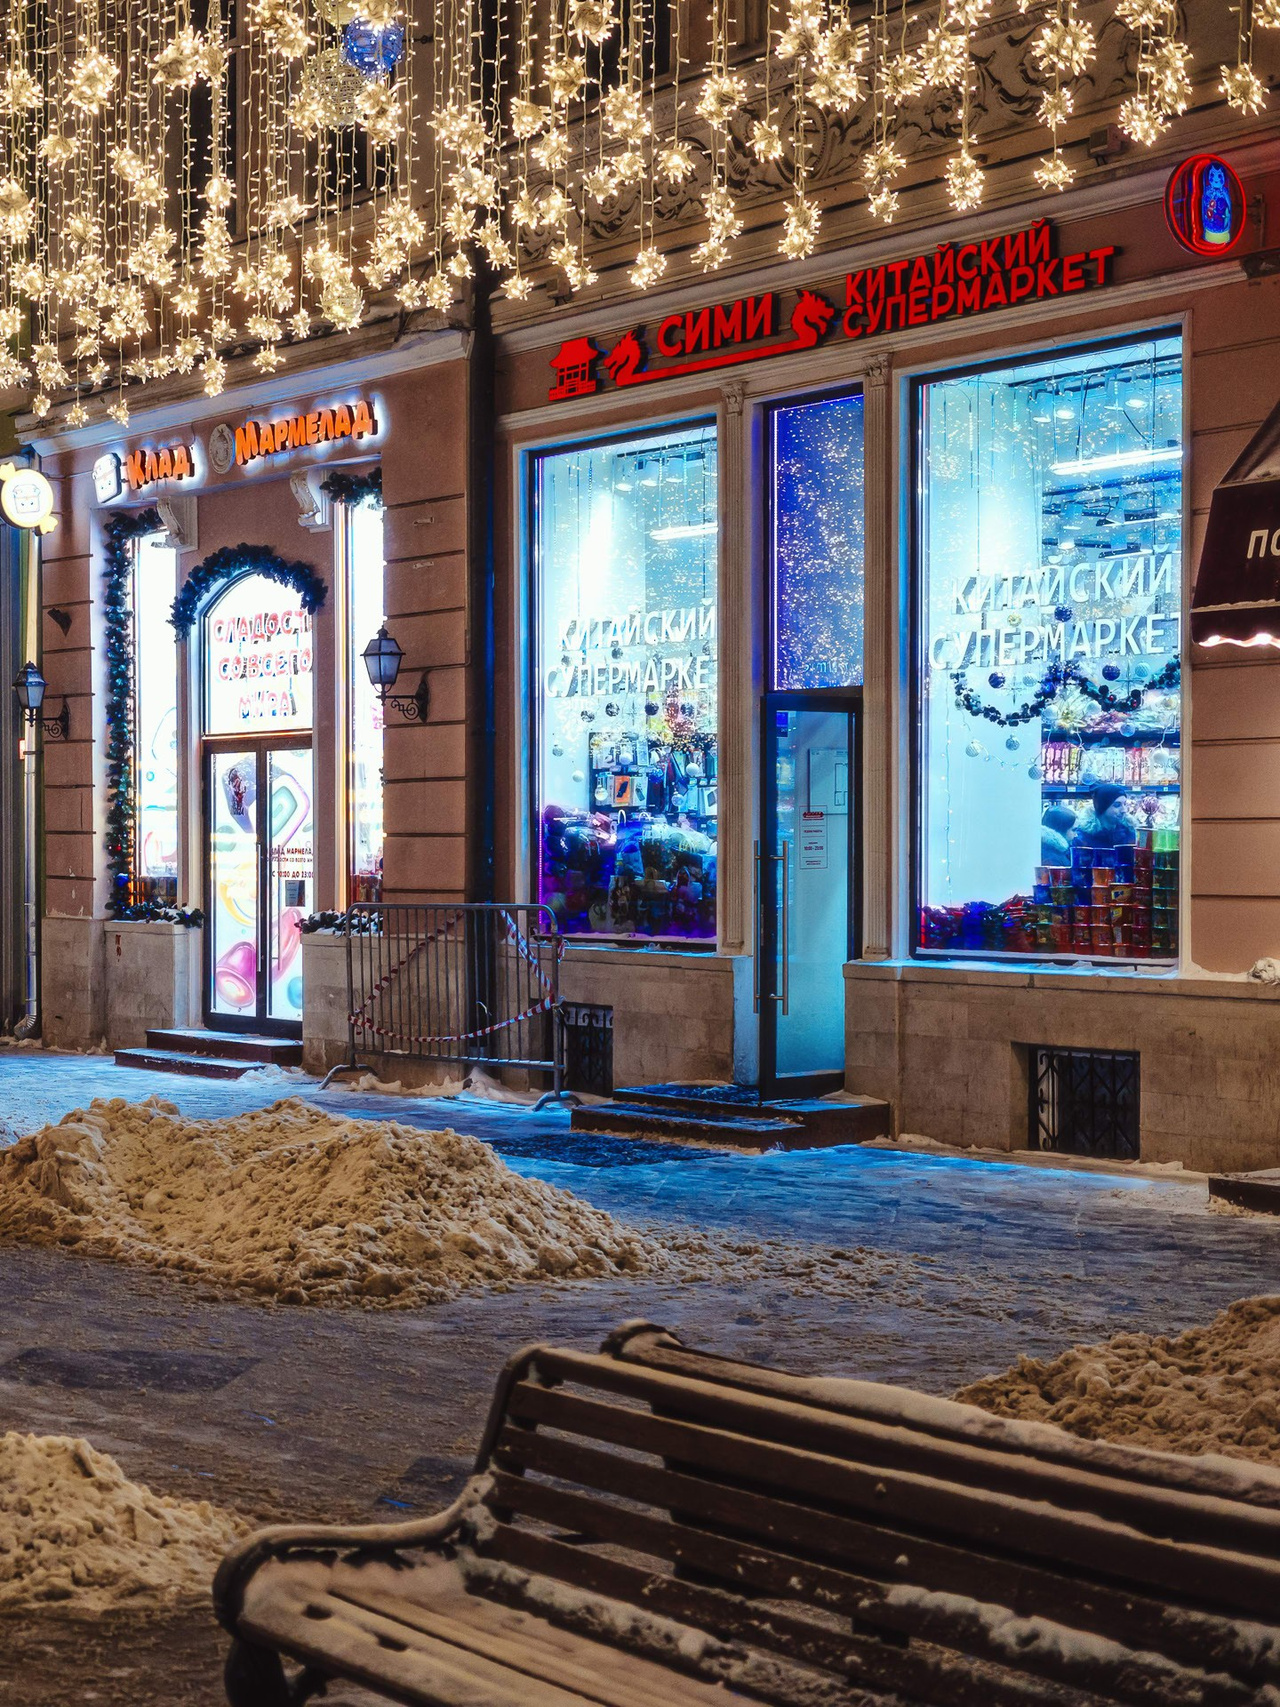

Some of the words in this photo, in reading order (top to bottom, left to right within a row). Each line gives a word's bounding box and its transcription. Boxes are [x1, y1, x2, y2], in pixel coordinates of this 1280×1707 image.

[842, 246, 1115, 338] СУПЕРМАРКЕТ
[846, 218, 1051, 306] КИТАЙСКИЙ
[657, 293, 774, 358] СИМИ
[127, 445, 193, 490] КЛАД
[235, 400, 375, 466] МАРМЕЛАД
[951, 543, 1174, 615] КИТАЙСКИЙ
[558, 597, 717, 651] КИТАЙСКИЙ
[544, 654, 717, 698] СУПЕРМАРКЕ
